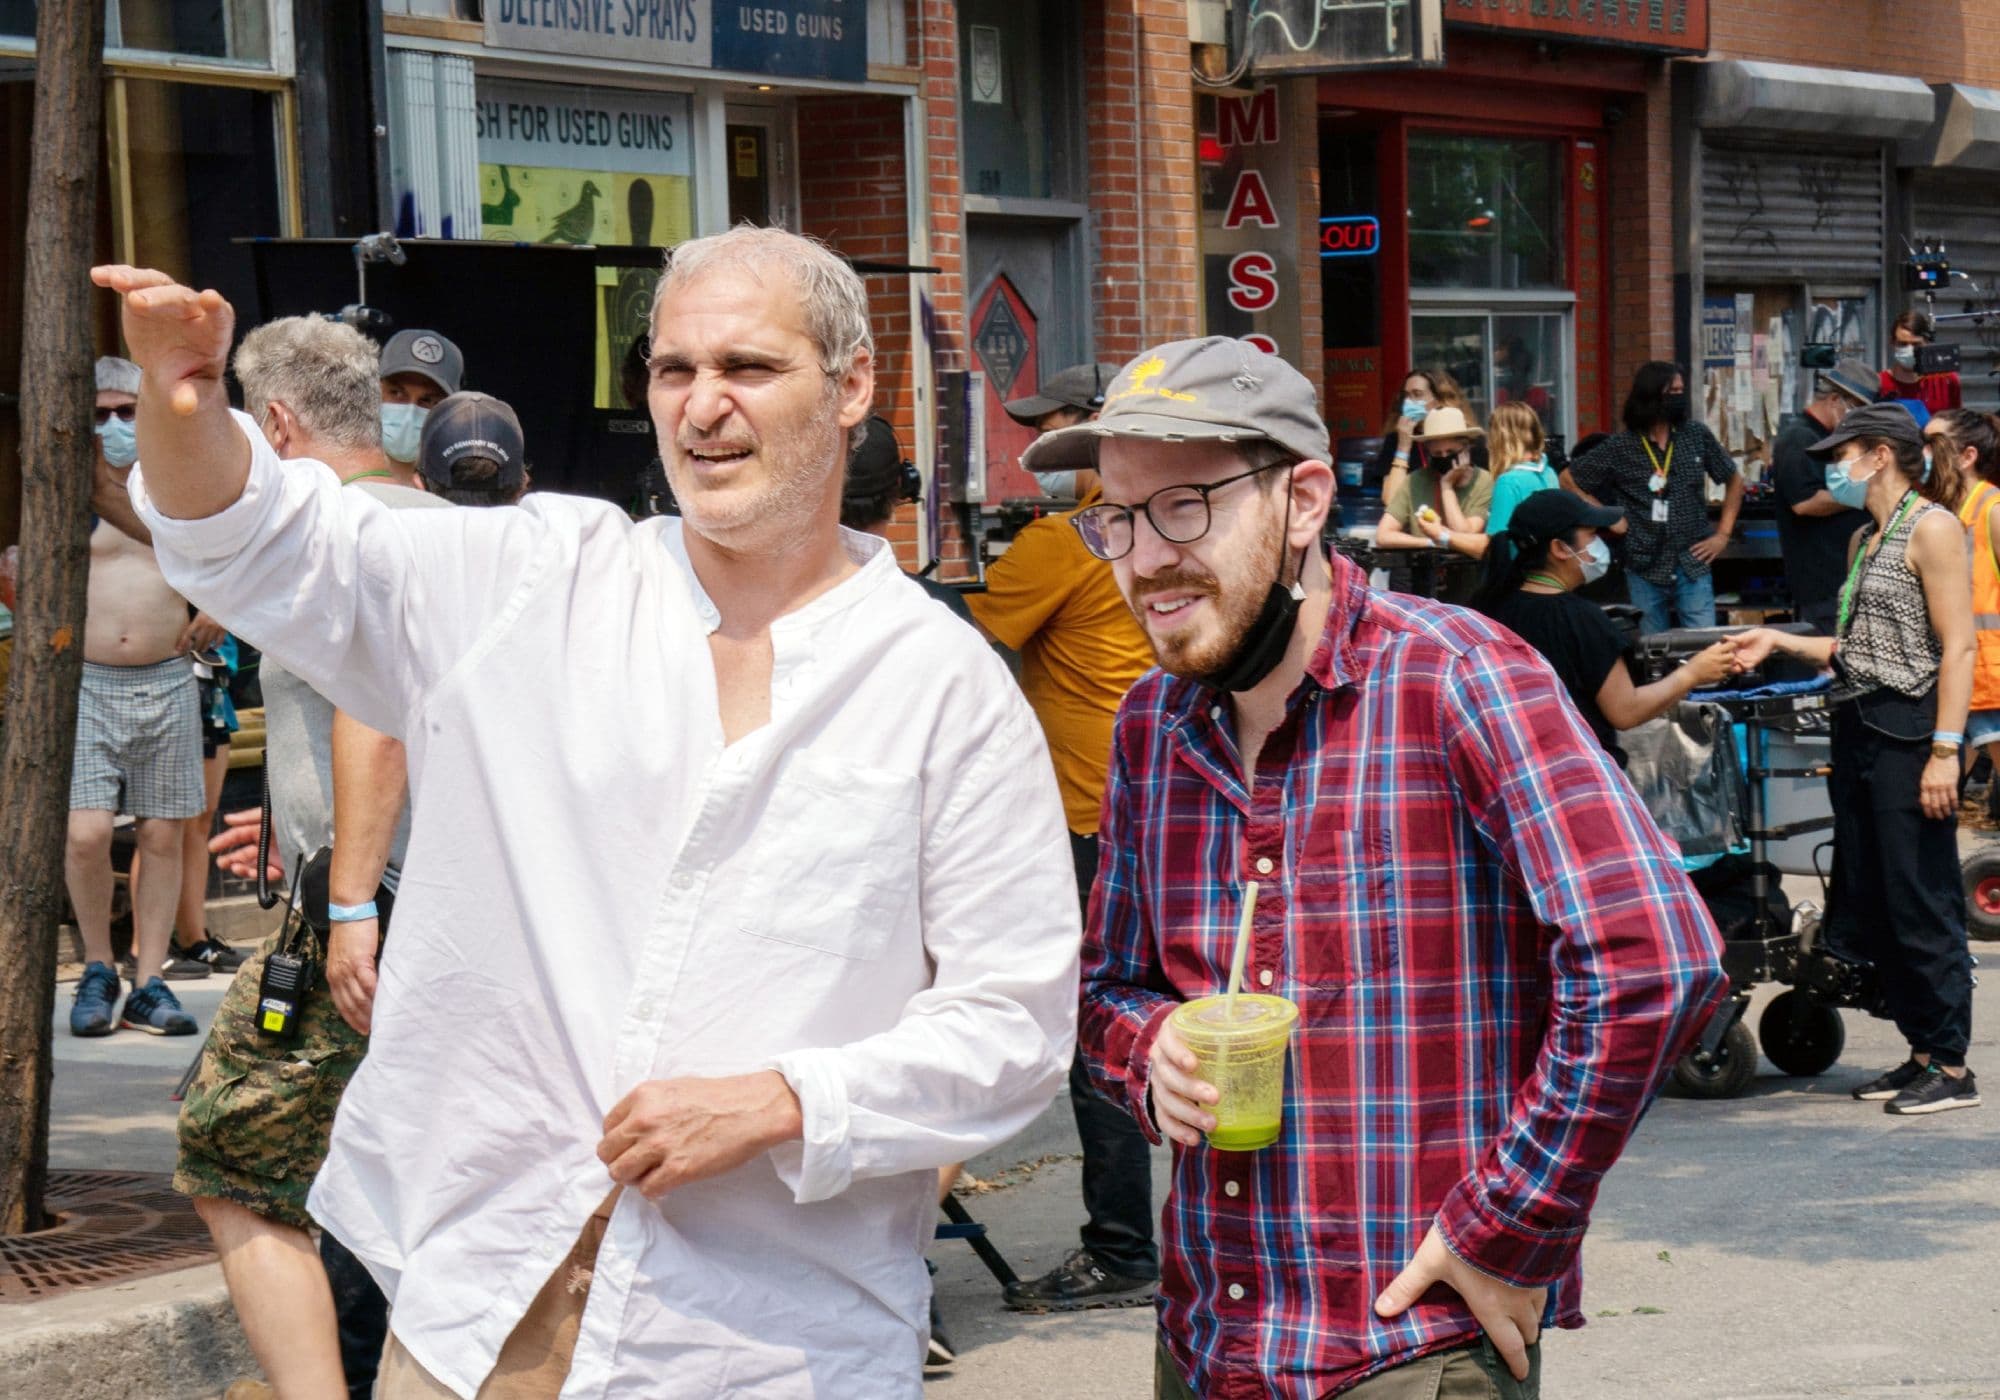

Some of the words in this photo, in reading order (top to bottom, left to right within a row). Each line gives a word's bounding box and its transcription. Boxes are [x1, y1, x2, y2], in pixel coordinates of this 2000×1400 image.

[622, 0, 697, 43] SPRAYS
[740, 6, 788, 35] USED
[796, 12, 842, 41] GUNS
[507, 103, 550, 142] FOR
[556, 107, 612, 146] USED
[618, 112, 673, 151] GUNS
